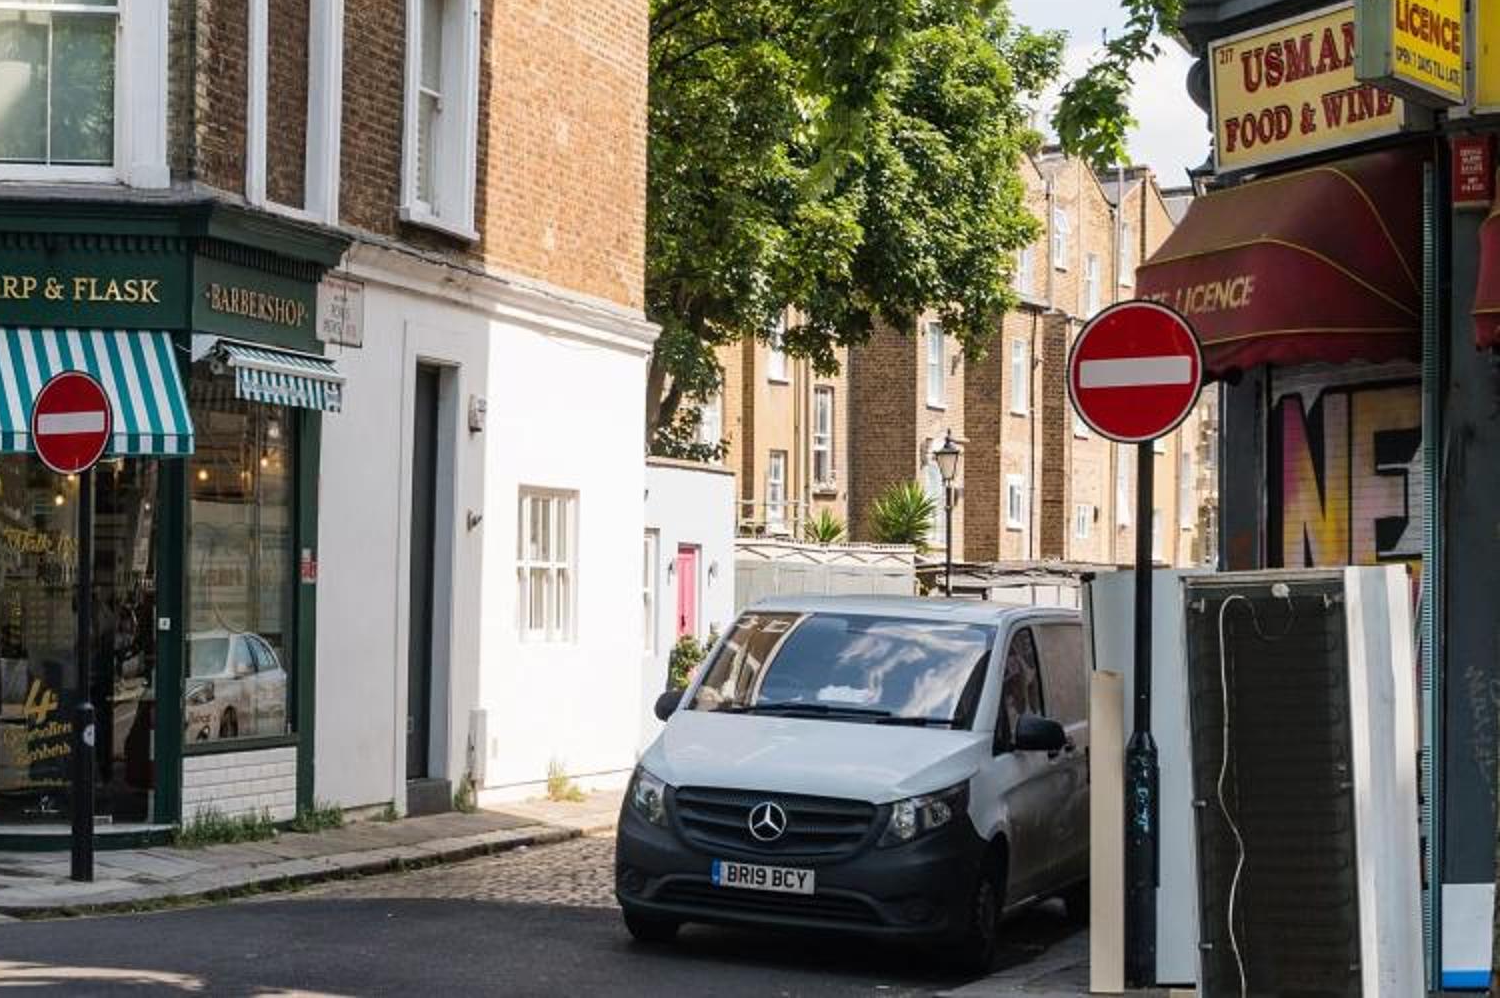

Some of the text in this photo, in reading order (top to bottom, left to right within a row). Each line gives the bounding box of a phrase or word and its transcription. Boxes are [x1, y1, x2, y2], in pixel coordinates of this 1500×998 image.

[1225, 84, 1394, 152] FOOD & WINE
[44, 277, 65, 299] &
[72, 277, 160, 303] FLASK
[211, 284, 305, 327] BARBERSHOP
[1175, 276, 1255, 315] LICENCE
[727, 865, 807, 889] BR19 BCY
